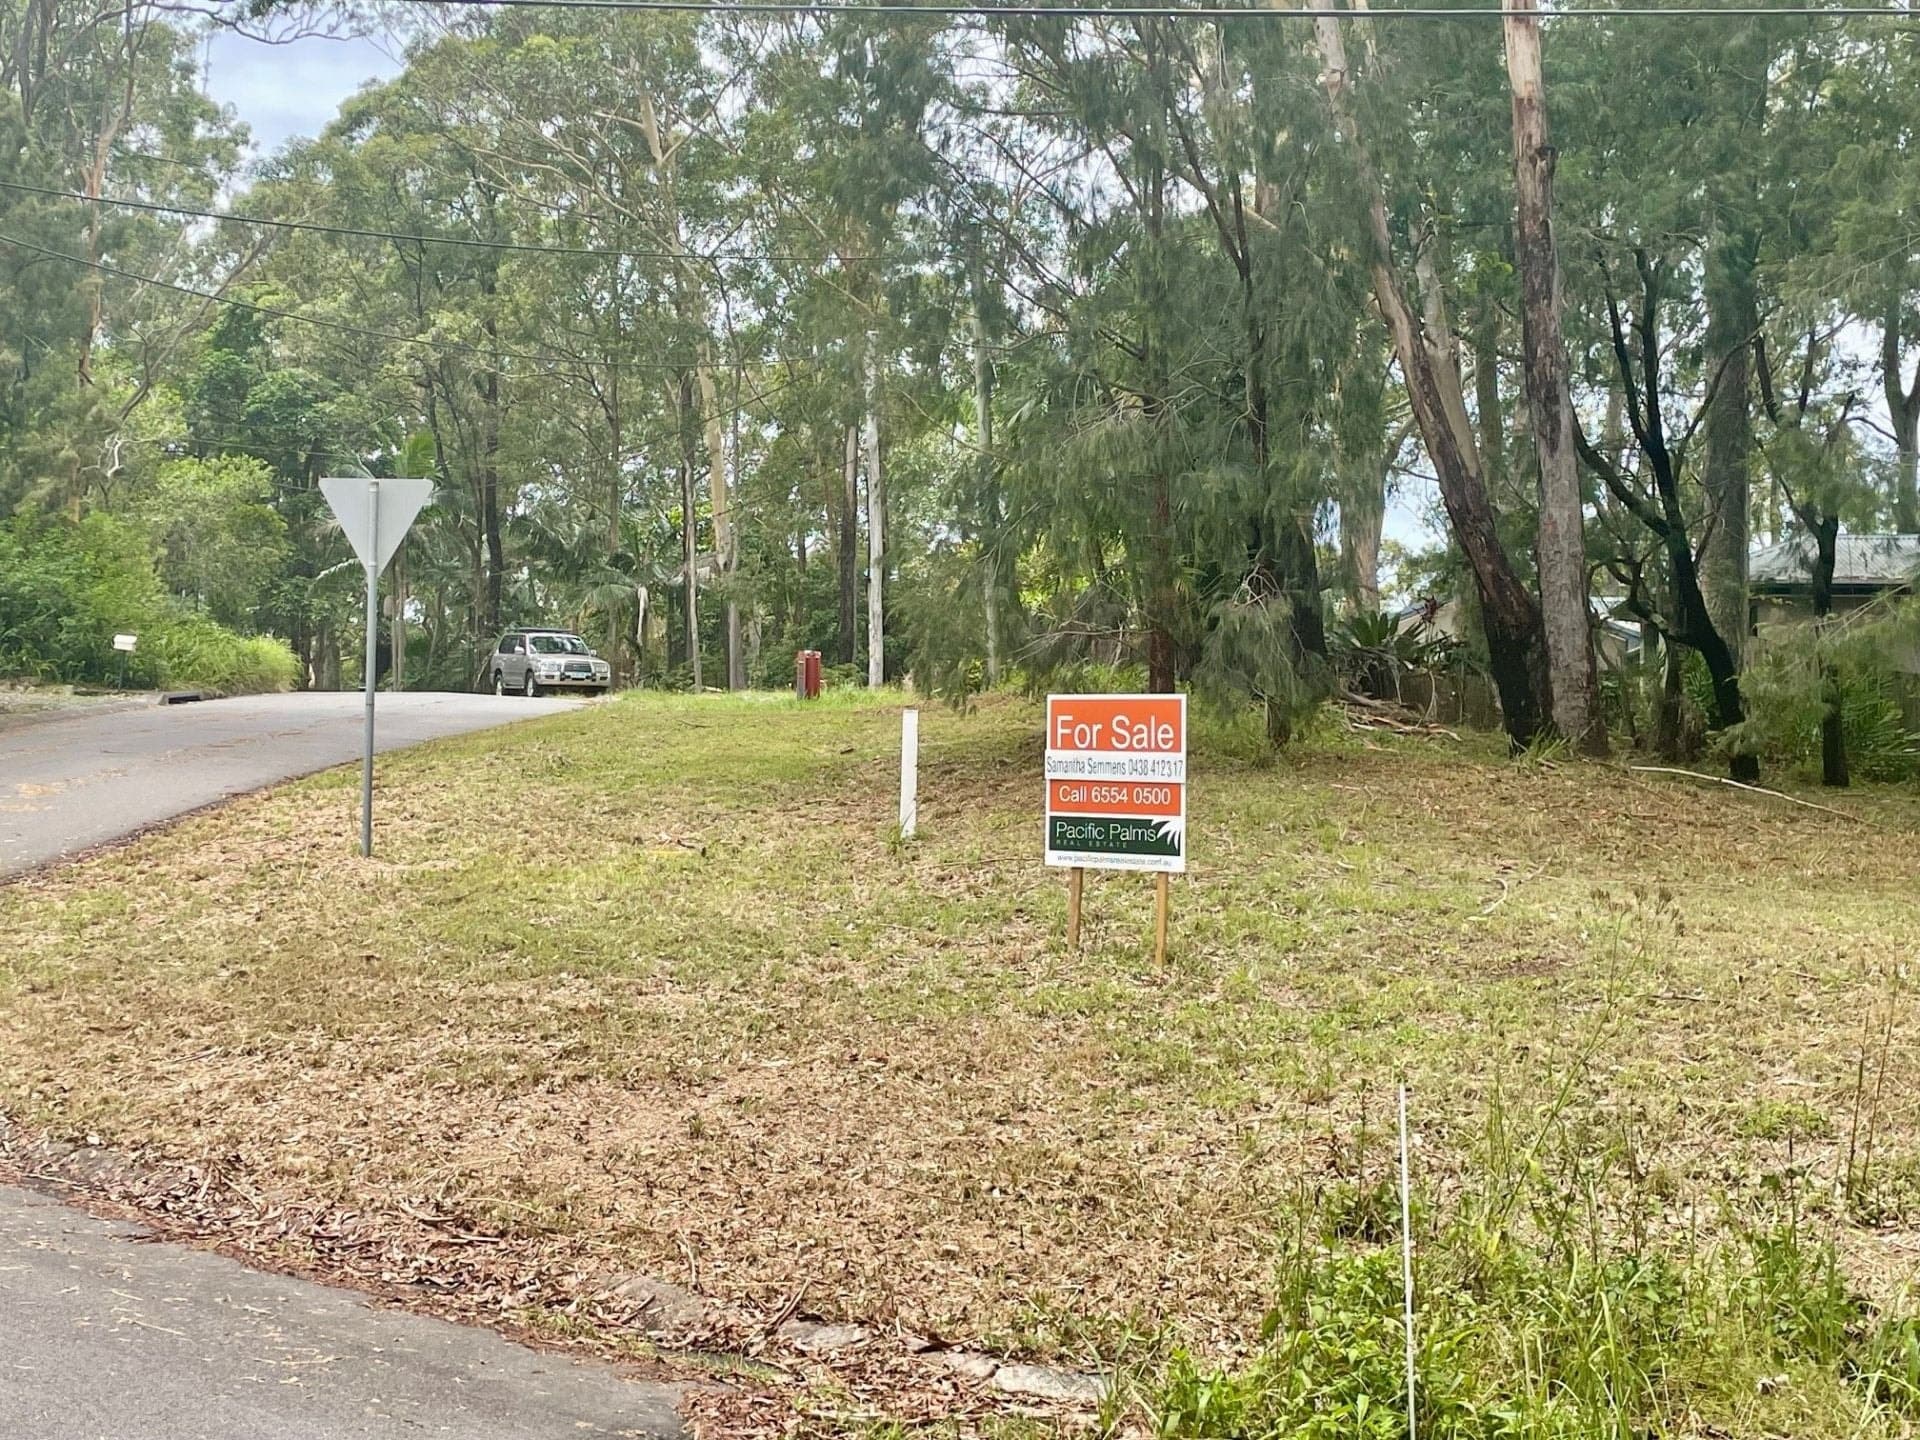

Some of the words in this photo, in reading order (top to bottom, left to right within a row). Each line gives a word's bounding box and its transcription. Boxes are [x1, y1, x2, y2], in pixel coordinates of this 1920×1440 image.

[1056, 715, 1103, 748] For
[1111, 714, 1174, 750] Sale
[1047, 756, 1086, 773] Samantha
[1087, 757, 1127, 776] Semmens
[1128, 758, 1149, 776] 0438
[1059, 785, 1087, 802] Call
[1091, 786, 1128, 804] 6554
[1133, 787, 1171, 805] 0500
[1056, 821, 1105, 840] Pacific
[1109, 823, 1156, 842] Palms
[1088, 841, 1128, 849] ESTATE
